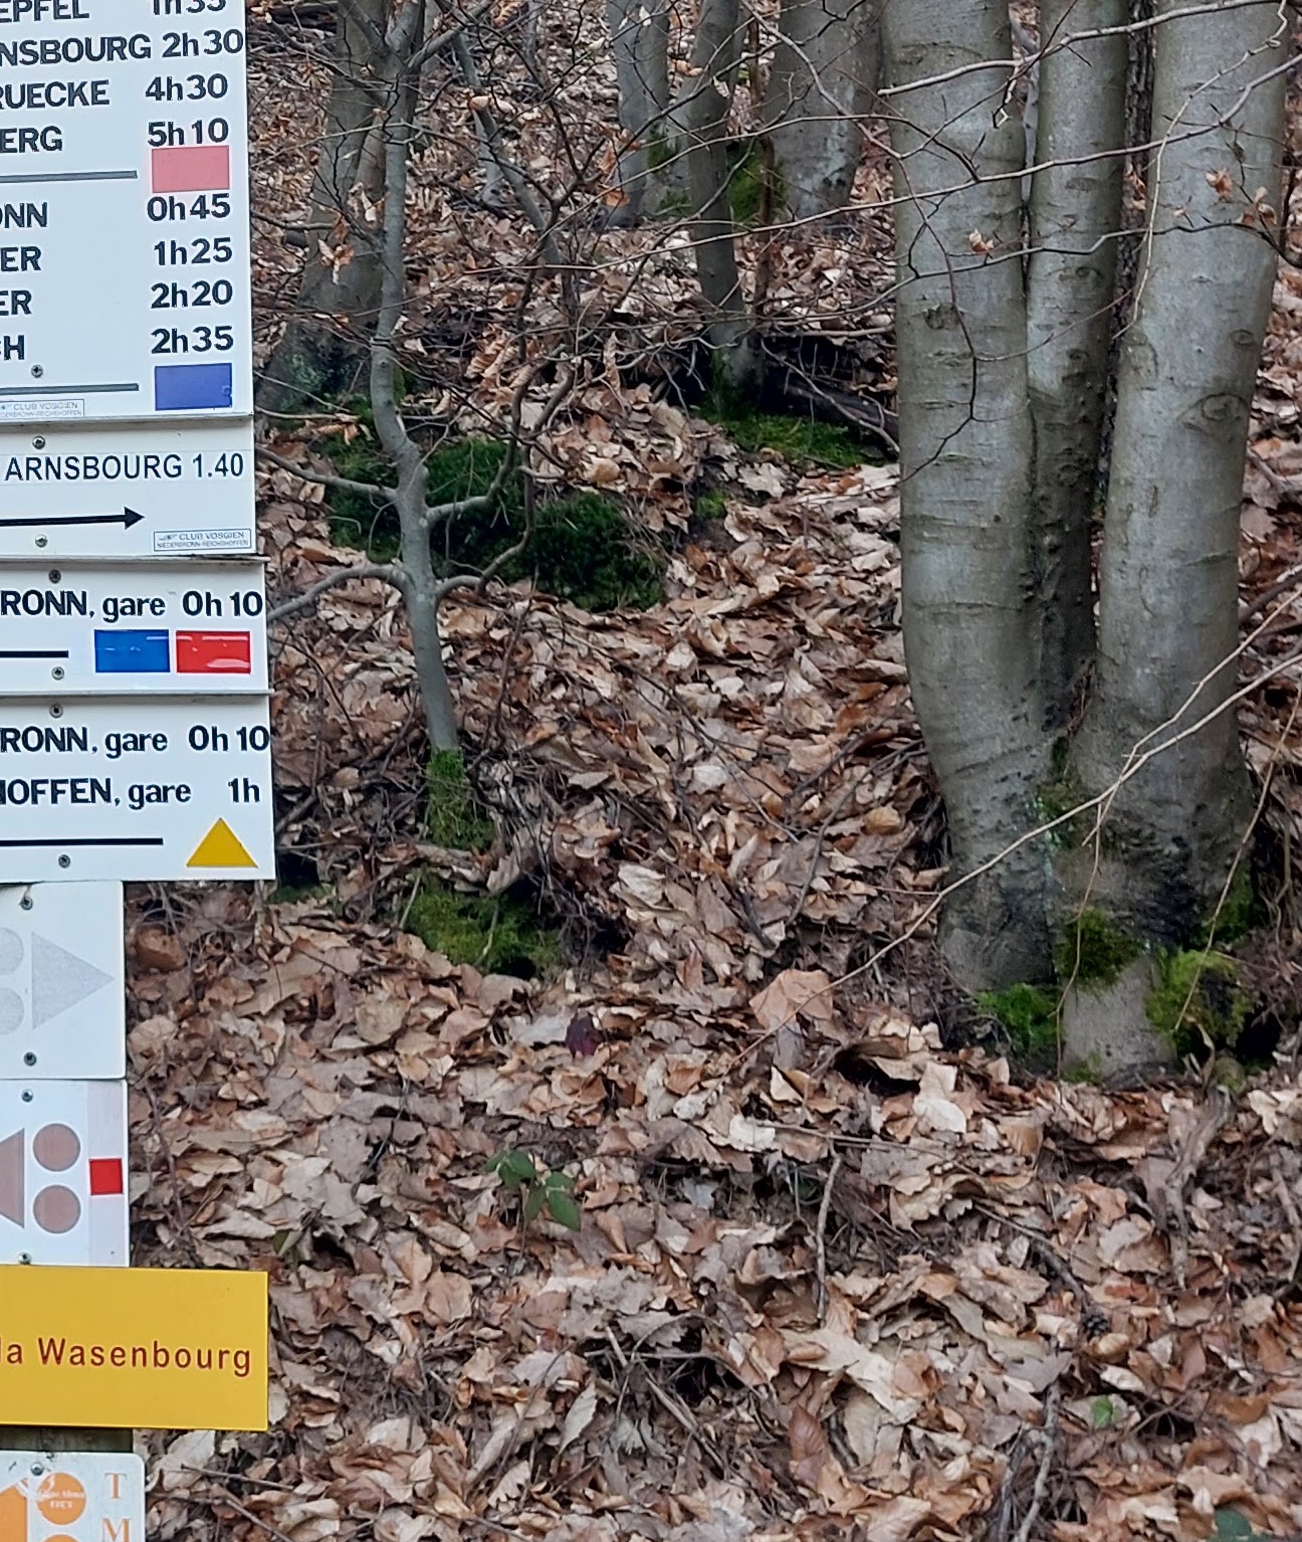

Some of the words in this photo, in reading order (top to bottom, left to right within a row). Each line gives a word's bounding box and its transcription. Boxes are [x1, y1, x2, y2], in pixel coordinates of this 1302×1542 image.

[4, 453, 183, 481] ARNSBOURG
[192, 452, 245, 479] 1.40
[101, 594, 166, 623] gare
[104, 730, 169, 760] gare
[127, 781, 192, 811] gare
[227, 776, 261, 804] 1h
[37, 1336, 253, 1378] Wasenbourg
